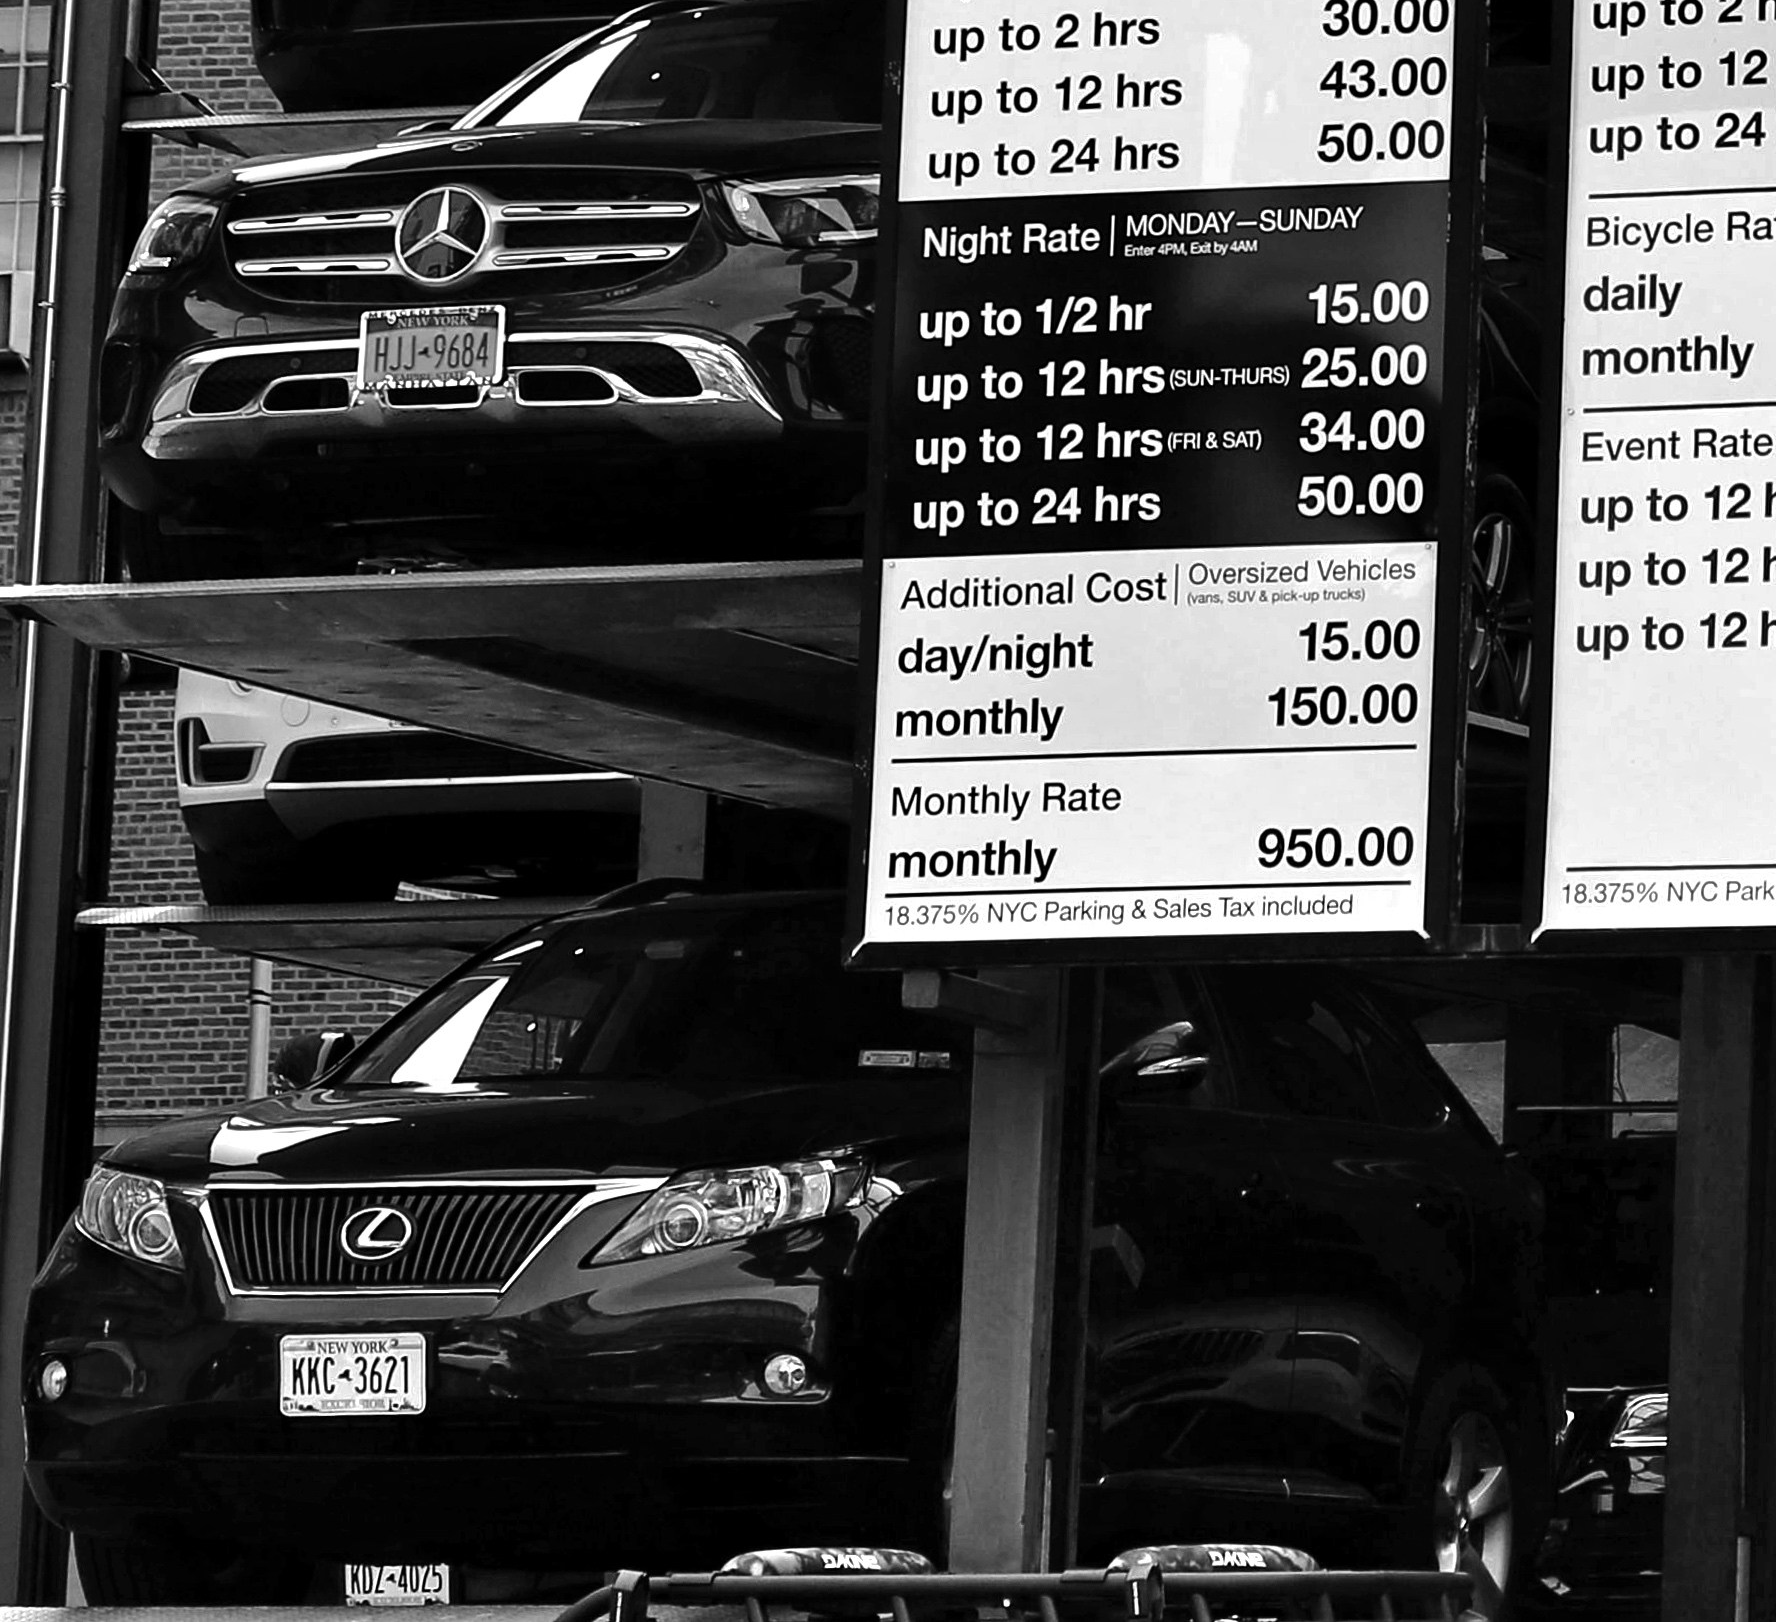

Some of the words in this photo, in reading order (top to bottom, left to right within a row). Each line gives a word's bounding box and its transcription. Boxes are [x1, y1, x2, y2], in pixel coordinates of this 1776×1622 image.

[923, 225, 1012, 263] Night
[1023, 223, 1100, 253] Rate
[1587, 213, 1714, 253] Bicycle
[1583, 273, 1683, 317] daily
[398, 315, 431, 328] NEW
[433, 315, 469, 326] YORK
[1583, 334, 1754, 379] monthly
[917, 374, 968, 410] up
[981, 365, 1023, 399] to
[1039, 360, 1085, 396] 12
[1099, 359, 1165, 395] hrs
[1170, 366, 1290, 391] (SUN-THURS)
[1301, 344, 1427, 388] 25.00
[1582, 431, 1680, 462] Event
[1694, 428, 1773, 458] Rate
[901, 574, 1074, 610] Additional
[1086, 572, 1167, 603] Cost
[1188, 561, 1308, 586] Oversized
[1317, 558, 1416, 581] Vehicles
[1187, 590, 1224, 606] (vans,
[1228, 590, 1256, 602] SUV
[1260, 590, 1269, 602] &
[1272, 589, 1320, 605] pick-up
[1323, 587, 1366, 603] trucks)
[898, 632, 1094, 681] day/night
[1299, 618, 1420, 661] 15.00
[896, 697, 1064, 742] monthly
[1268, 683, 1418, 726] 150.00
[892, 783, 1031, 821] Monthly
[1043, 782, 1121, 812] Rate
[889, 839, 1058, 883] monthly
[1258, 826, 1414, 868] 950.00
[317, 1342, 348, 1354] NEW
[350, 1341, 388, 1353] YORK
